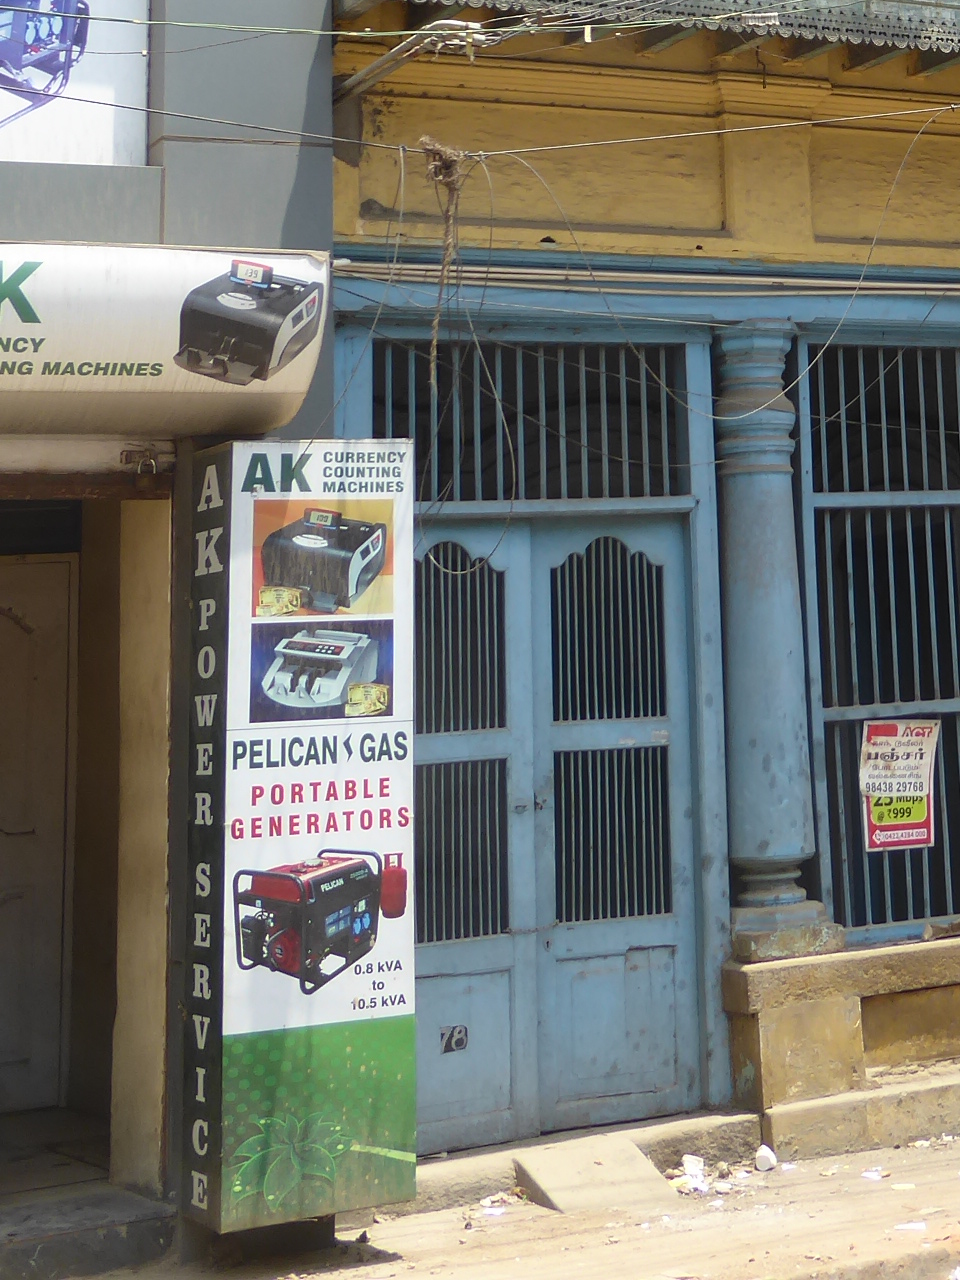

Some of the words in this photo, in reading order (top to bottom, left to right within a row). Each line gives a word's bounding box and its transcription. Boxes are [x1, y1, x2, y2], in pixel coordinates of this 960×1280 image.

[41, 361, 164, 377] MACHINES
[241, 452, 312, 493] AK
[323, 451, 407, 464] CURRENCY
[323, 466, 401, 478] COUNTING
[322, 481, 404, 494] MACHINES
[902, 726, 933, 738] ACT
[232, 735, 338, 771] PELICAN
[359, 731, 408, 763] GAS
[251, 777, 390, 807] PORTABLE
[865, 781, 894, 793] 98438
[896, 781, 924, 793] 29768
[231, 806, 410, 840] GENERATORS
[320, 877, 345, 893] PELICAN
[354, 963, 374, 976] 0.8
[377, 960, 403, 973] kVA
[372, 978, 385, 991] to
[351, 997, 378, 1011] 10.5
[381, 993, 407, 1008] kVA
